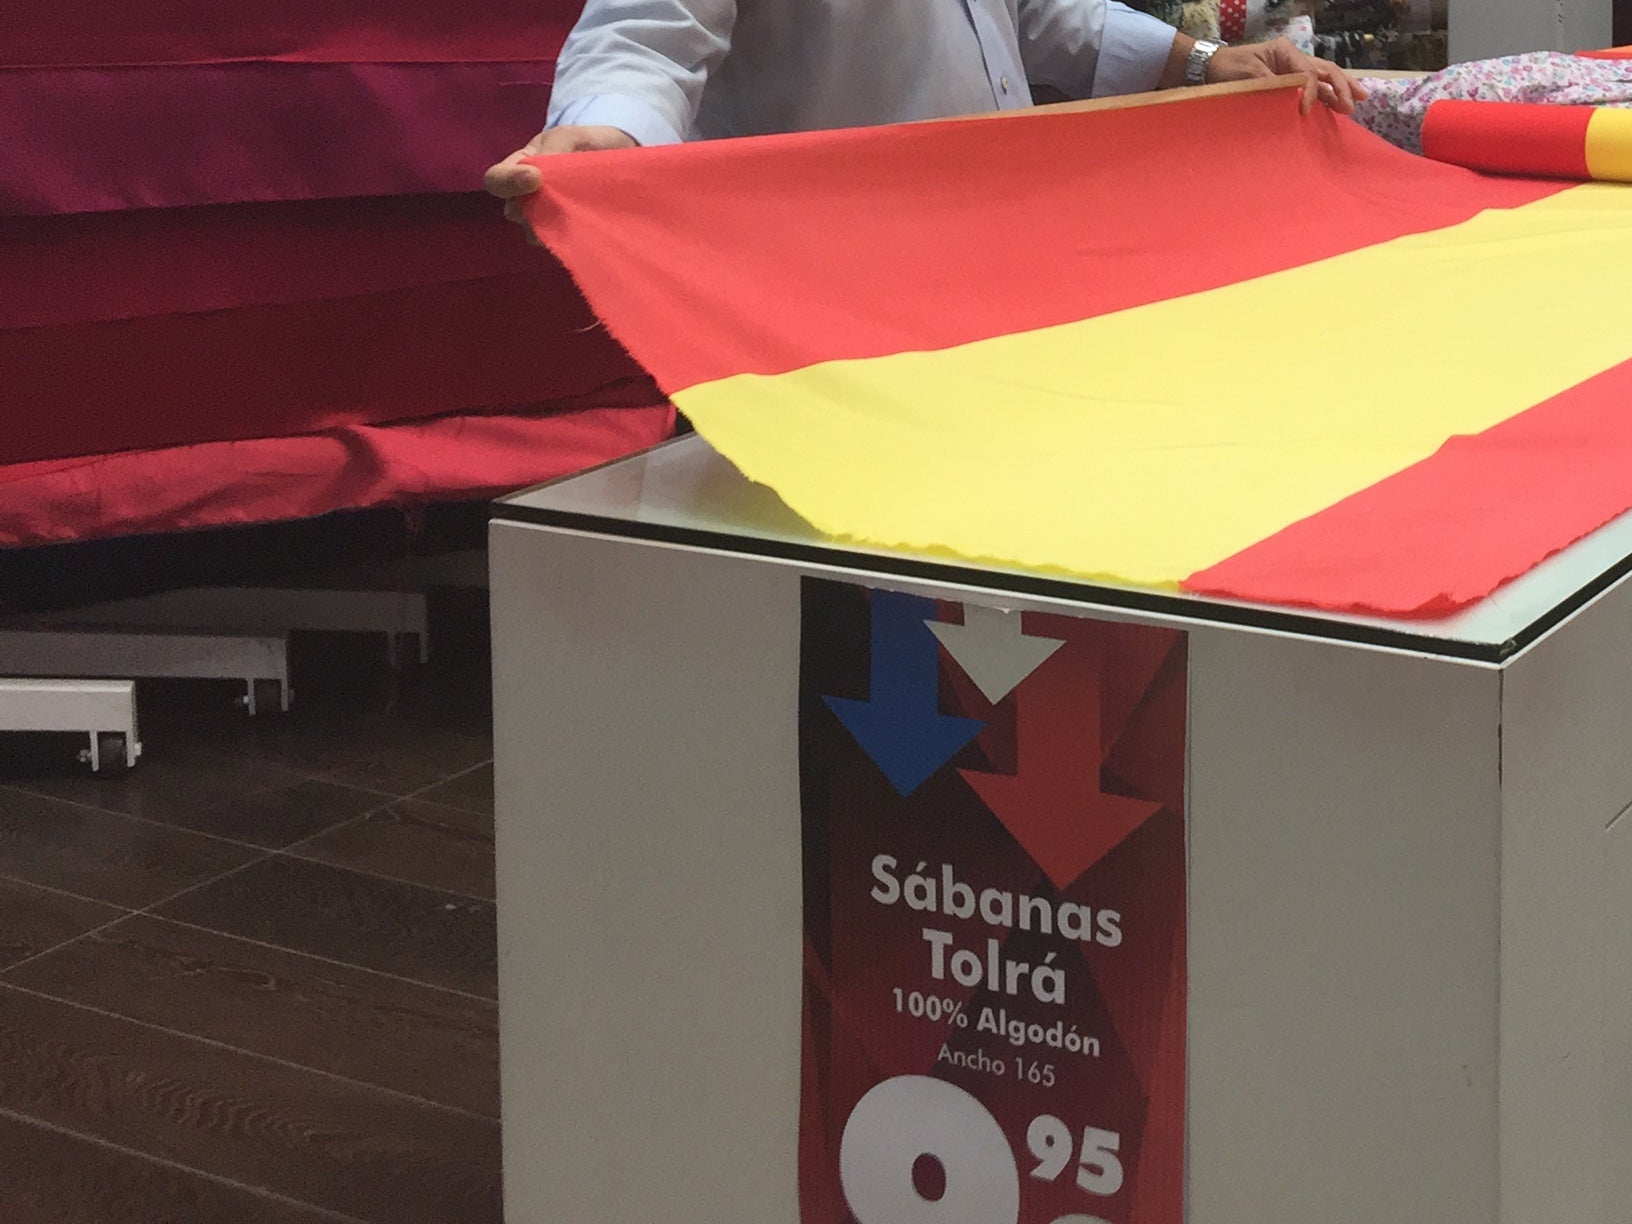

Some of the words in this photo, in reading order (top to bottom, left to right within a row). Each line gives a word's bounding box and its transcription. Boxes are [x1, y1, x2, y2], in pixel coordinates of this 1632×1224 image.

[870, 854, 1123, 948] Sábanas
[922, 927, 1066, 1005] Tolrá
[892, 987, 968, 1028] 100%
[976, 1006, 1100, 1057] Algodón
[937, 1042, 1005, 1076] Ancho
[1014, 1057, 1056, 1087] 165
[1026, 1113, 1124, 1197] 95
